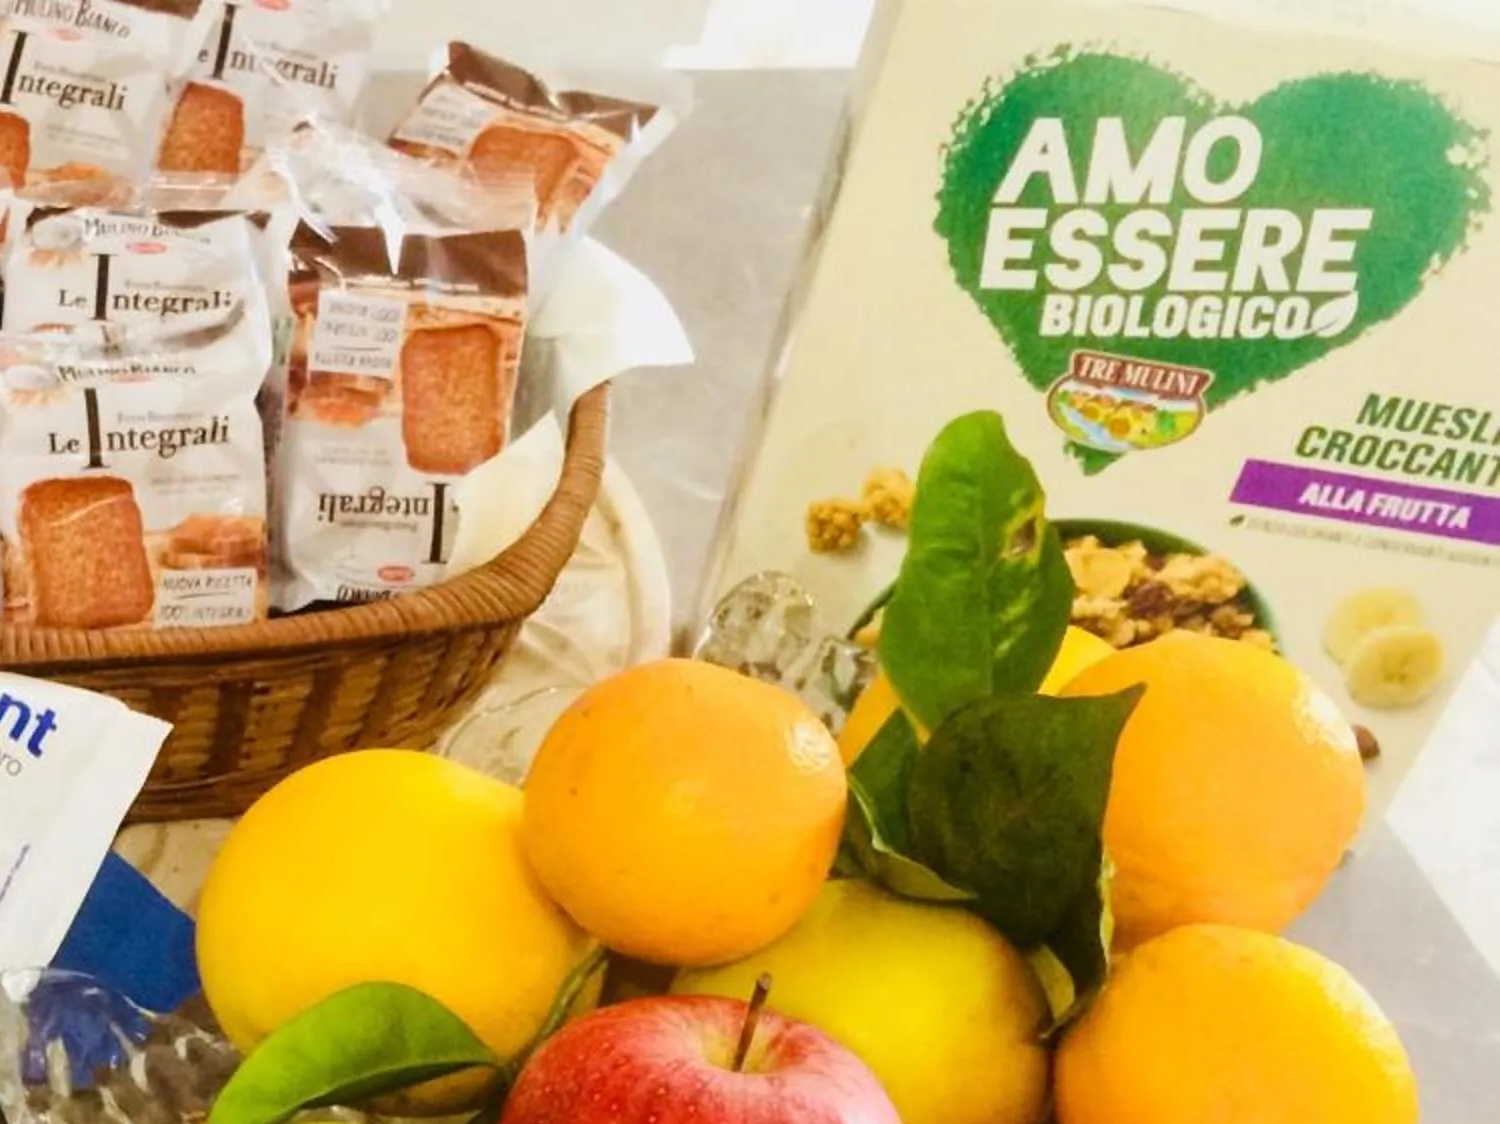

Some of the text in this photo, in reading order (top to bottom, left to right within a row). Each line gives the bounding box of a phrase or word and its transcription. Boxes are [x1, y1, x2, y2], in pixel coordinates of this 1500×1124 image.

[993, 115, 1264, 205] AMO
[979, 208, 1374, 292] ESSERE
[58, 288, 88, 307] Le
[1039, 294, 1306, 340] BIOLOGICO
[1077, 355, 1200, 397] TRE MULINI
[48, 388, 231, 469] Le Integrali
[1296, 426, 1500, 488] CROCCANT
[317, 482, 451, 566] Integrali
[1299, 481, 1471, 530] ALLA FRUTTA
